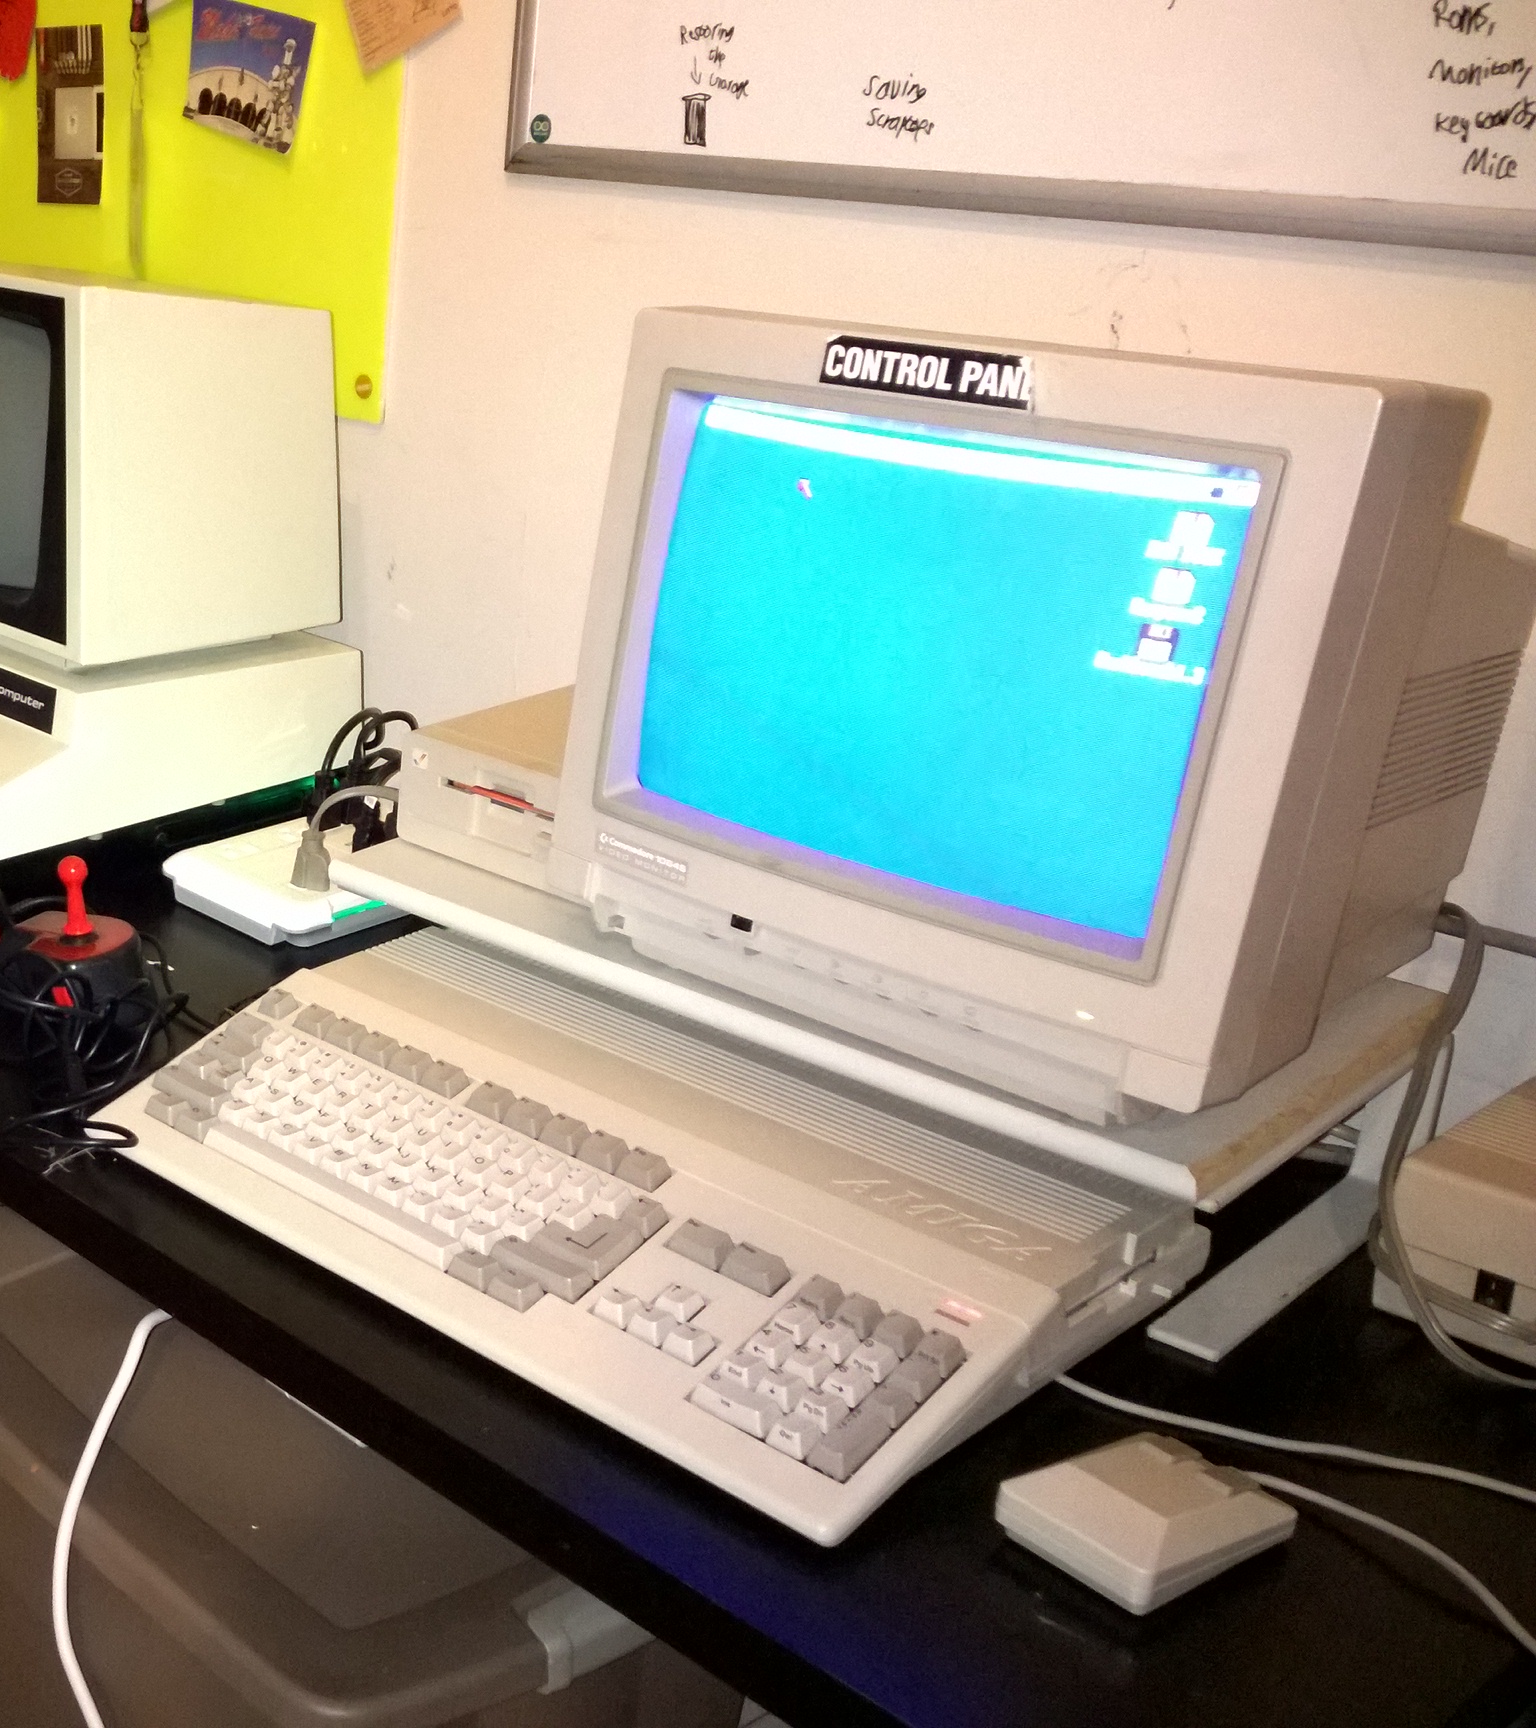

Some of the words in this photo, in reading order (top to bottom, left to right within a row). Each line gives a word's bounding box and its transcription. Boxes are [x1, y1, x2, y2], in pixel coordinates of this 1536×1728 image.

[862, 73, 927, 104] Saving
[1463, 147, 1518, 180] Mice
[824, 344, 953, 391] CONTROL
[609, 837, 654, 861] Commodore
